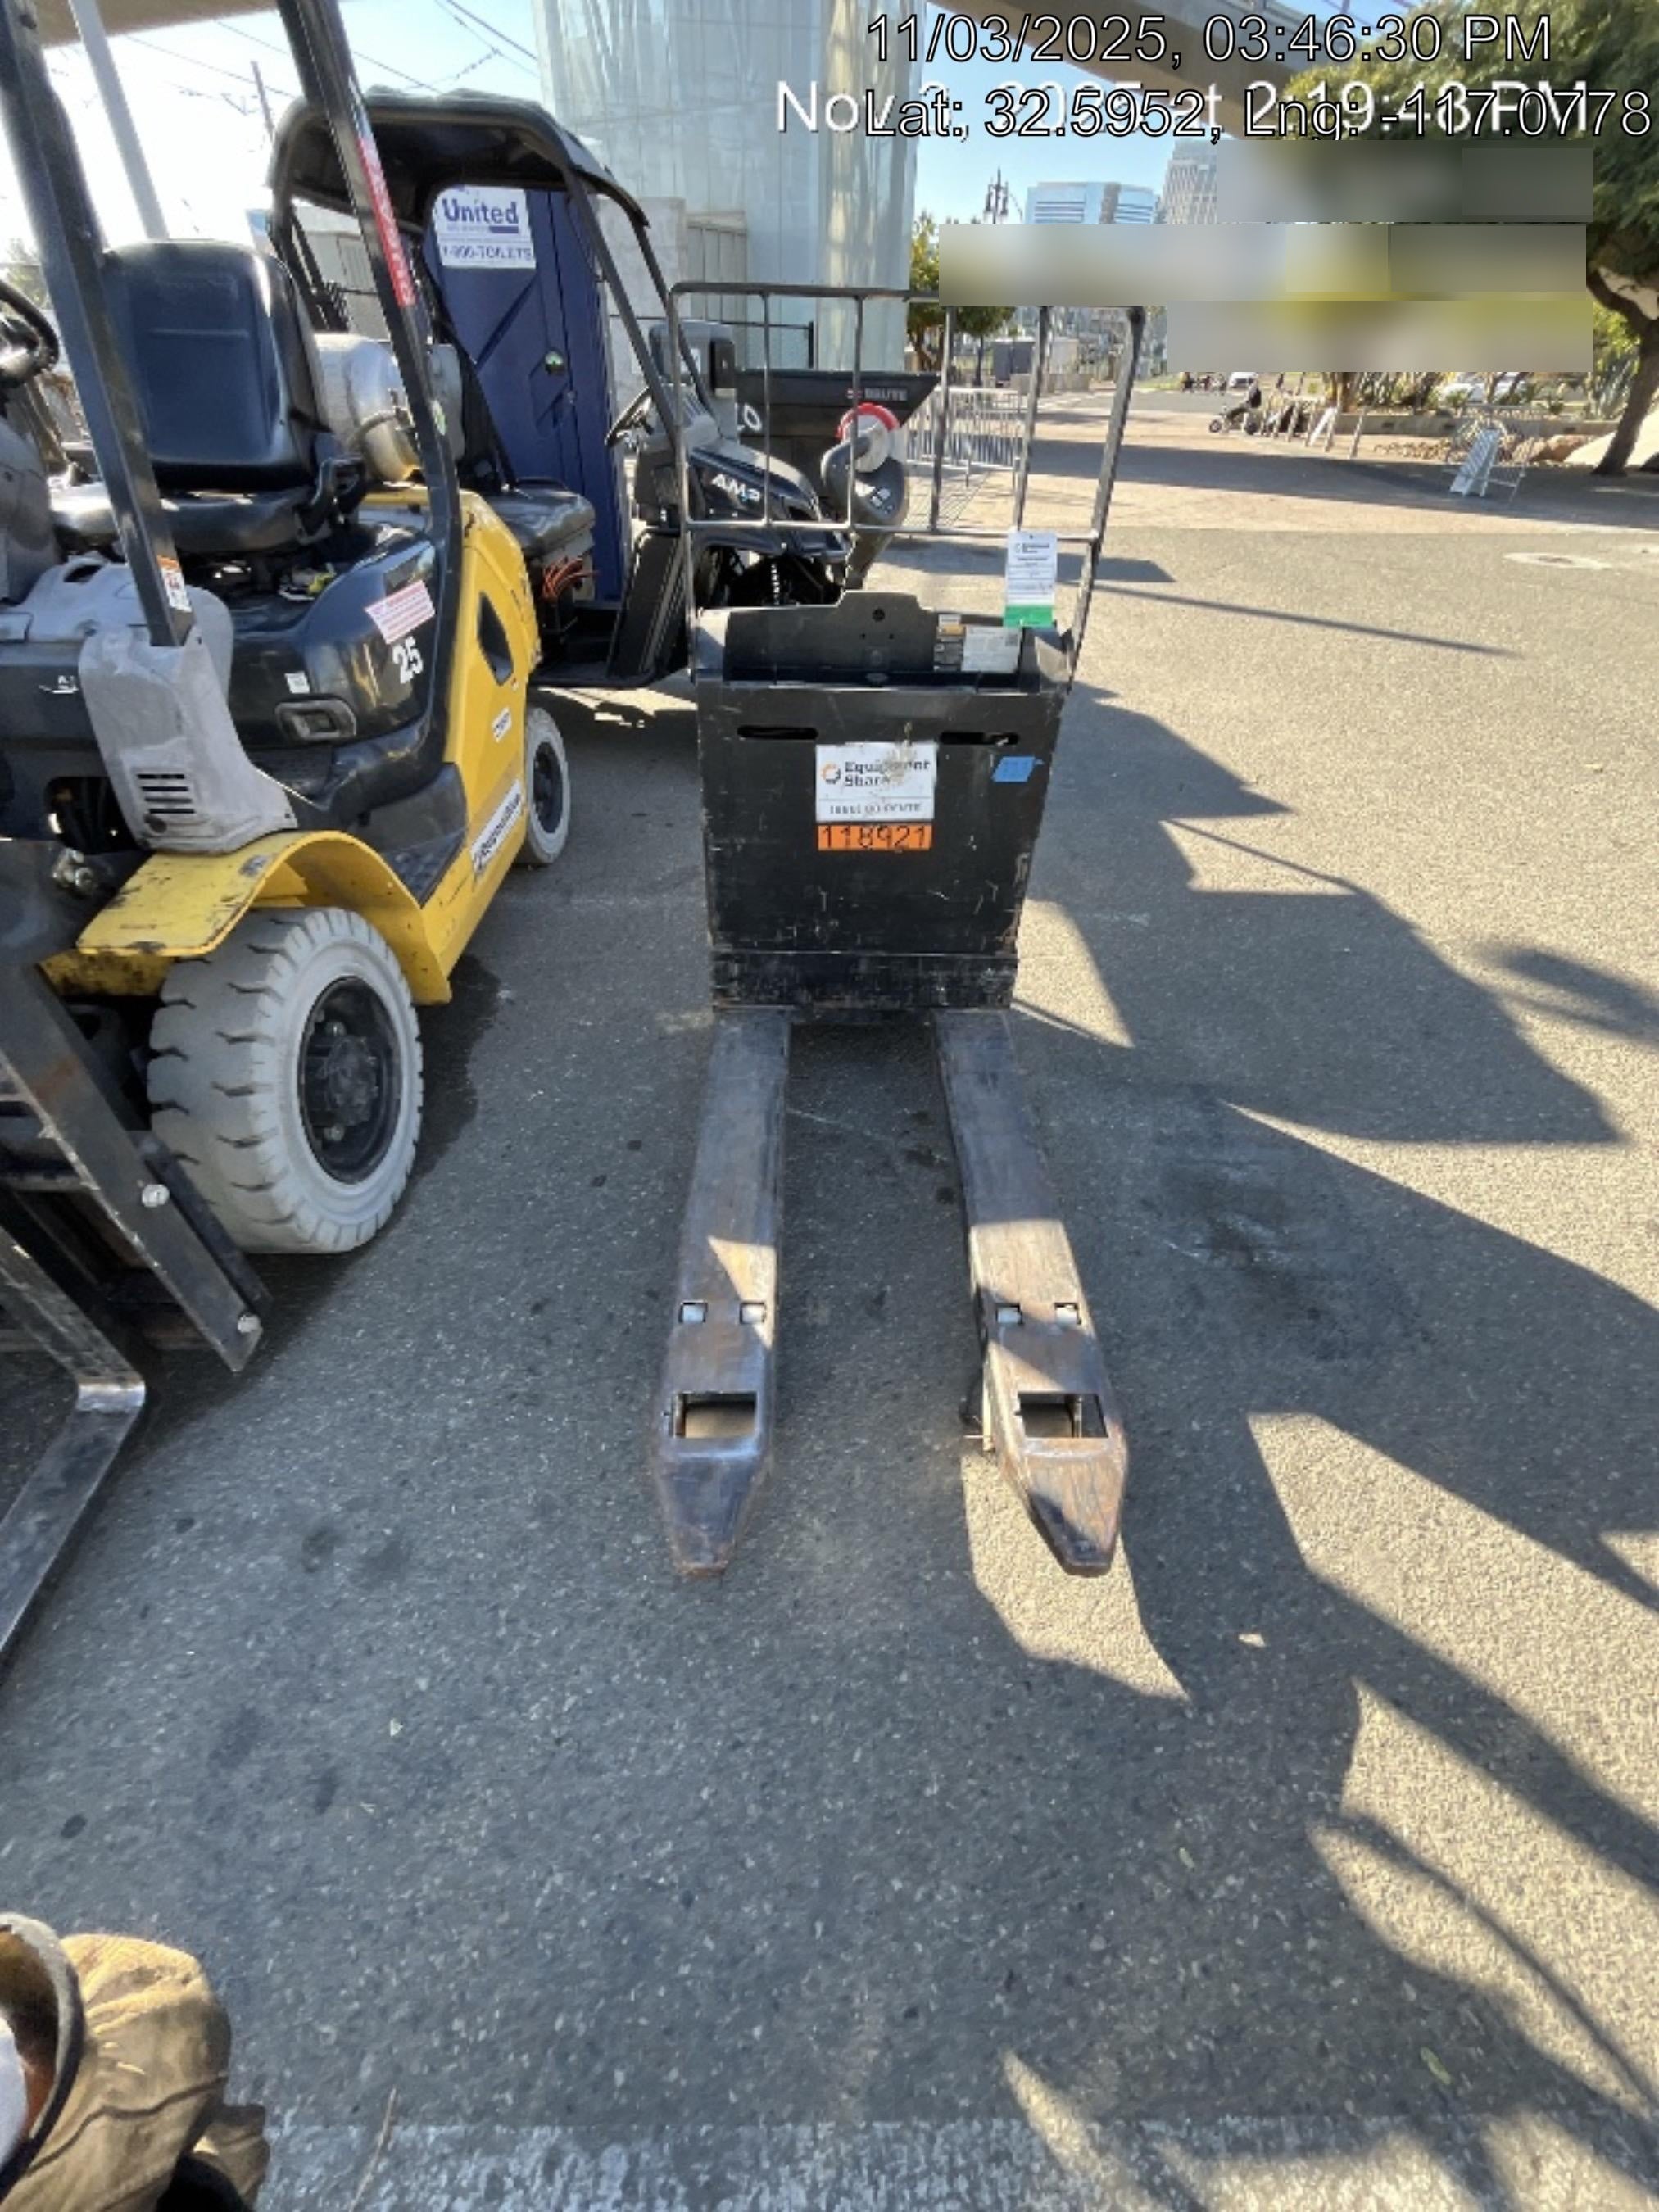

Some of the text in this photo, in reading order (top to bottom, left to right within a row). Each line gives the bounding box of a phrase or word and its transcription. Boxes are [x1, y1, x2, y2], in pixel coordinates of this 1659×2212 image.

[442, 198, 519, 224] United
[392, 636, 424, 684] 25
[822, 825, 926, 849] 118921
